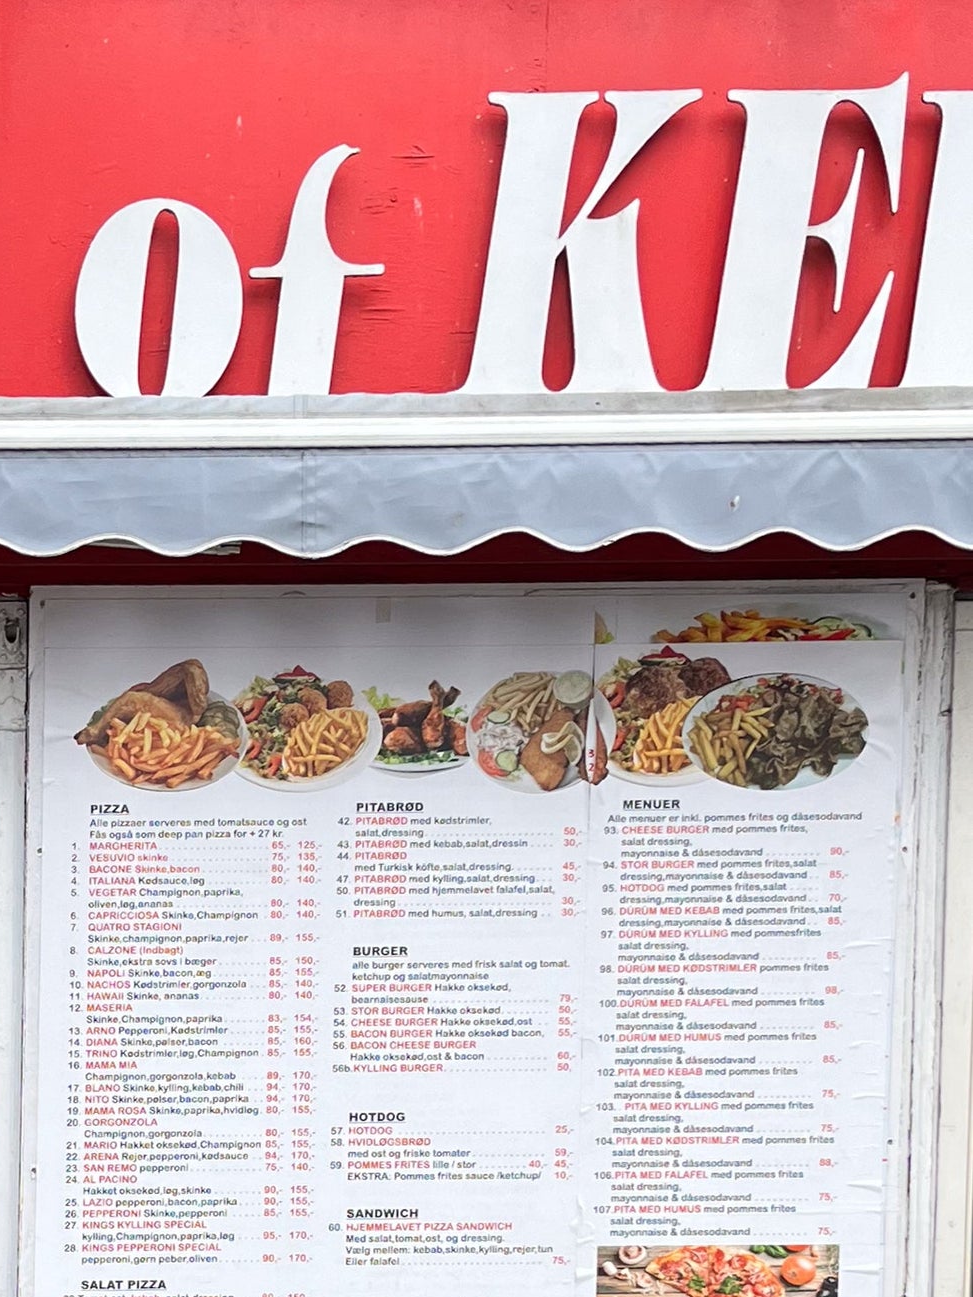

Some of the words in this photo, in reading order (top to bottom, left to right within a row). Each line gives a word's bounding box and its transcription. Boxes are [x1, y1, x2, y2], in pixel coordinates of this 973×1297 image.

[74, 143, 387, 399] of
[90, 804, 130, 815] PIZZA
[356, 802, 424, 813] PITABRØD
[622, 799, 680, 810] MENUER
[89, 818, 109, 828] Alle
[110, 819, 147, 829] pizzaer
[148, 819, 192, 828] serveres
[193, 817, 216, 827] med
[217, 817, 275, 827] tomatsauce
[276, 819, 290, 829] og
[291, 817, 308, 827] ost
[355, 816, 409, 826] PITABRØD
[410, 816, 432, 826] med
[607, 814, 627, 824] Alle
[628, 815, 667, 823] menuer
[668, 815, 680, 823] er
[703, 814, 746, 824] pommes
[748, 812, 774, 822] frites
[775, 814, 789, 824] og
[89, 830, 107, 839] Fås
[108, 829, 133, 841] også
[135, 831, 156, 839] som
[157, 830, 183, 841] deep
[184, 831, 204, 841] pan
[205, 830, 231, 840] pizza
[233, 829, 248, 838] for
[257, 828, 270, 838] 27
[621, 825, 664, 835] CHEESE
[666, 824, 710, 835] BURGER
[711, 824, 734, 834] med
[735, 825, 778, 835] pommes
[89, 841, 158, 851] MARGHERITA
[88, 853, 135, 863] VESUVIO
[137, 853, 169, 862] skinke
[354, 851, 408, 860] PITABRØD
[88, 876, 136, 885] ITALIANA
[87, 922, 131, 932] QUATRO
[133, 922, 182, 932] STAGIONI
[87, 945, 137, 955] CALZONE
[353, 946, 408, 957] BURGER
[351, 961, 370, 970] alle
[371, 961, 405, 971] burger
[406, 962, 450, 970] serveres
[451, 959, 473, 969] med
[474, 959, 497, 969] frisk
[498, 959, 523, 969] salat
[524, 961, 538, 970] og
[351, 983, 387, 993] SUPER
[388, 983, 432, 993] BURGER
[434, 983, 466, 992] Hakke
[86, 1003, 133, 1013] MASERIA
[350, 1018, 392, 1027] CHEESE
[394, 1017, 439, 1027] BURGER
[440, 1017, 472, 1027] Hakke
[86, 1026, 116, 1035] ARNO
[84, 1117, 158, 1127] GORGONZOLA
[349, 1111, 406, 1123] HOTDOG
[348, 1126, 393, 1136] HOTDOG
[348, 1137, 431, 1147] HVIDLØGSBRØD
[347, 1149, 369, 1158] med
[370, 1149, 387, 1158] ost
[388, 1150, 401, 1160] og
[403, 1148, 431, 1158] friske
[432, 1149, 472, 1158] tomater
[83, 1163, 105, 1173] SAN
[107, 1163, 138, 1173] REMO
[139, 1163, 189, 1174] pepperoni
[347, 1160, 392, 1170] POMMES
[394, 1160, 431, 1169] FRITES
[346, 1208, 419, 1219] SANDWICH
[638, 1204, 662, 1214] MED
[663, 1204, 702, 1214] HUMUS
[703, 1204, 725, 1214] med
[726, 1206, 769, 1215] pommes
[770, 1203, 797, 1213] frites
[82, 1220, 115, 1230] KINGS
[117, 1220, 162, 1230] KYLLING
[163, 1219, 207, 1229] SPECIAL
[346, 1222, 422, 1232] HJEMMELAVET
[423, 1222, 454, 1232] PIZZA
[456, 1221, 513, 1231] SANDWICH
[81, 1280, 124, 1290] SALAT
[127, 1279, 167, 1290] PIZZA
